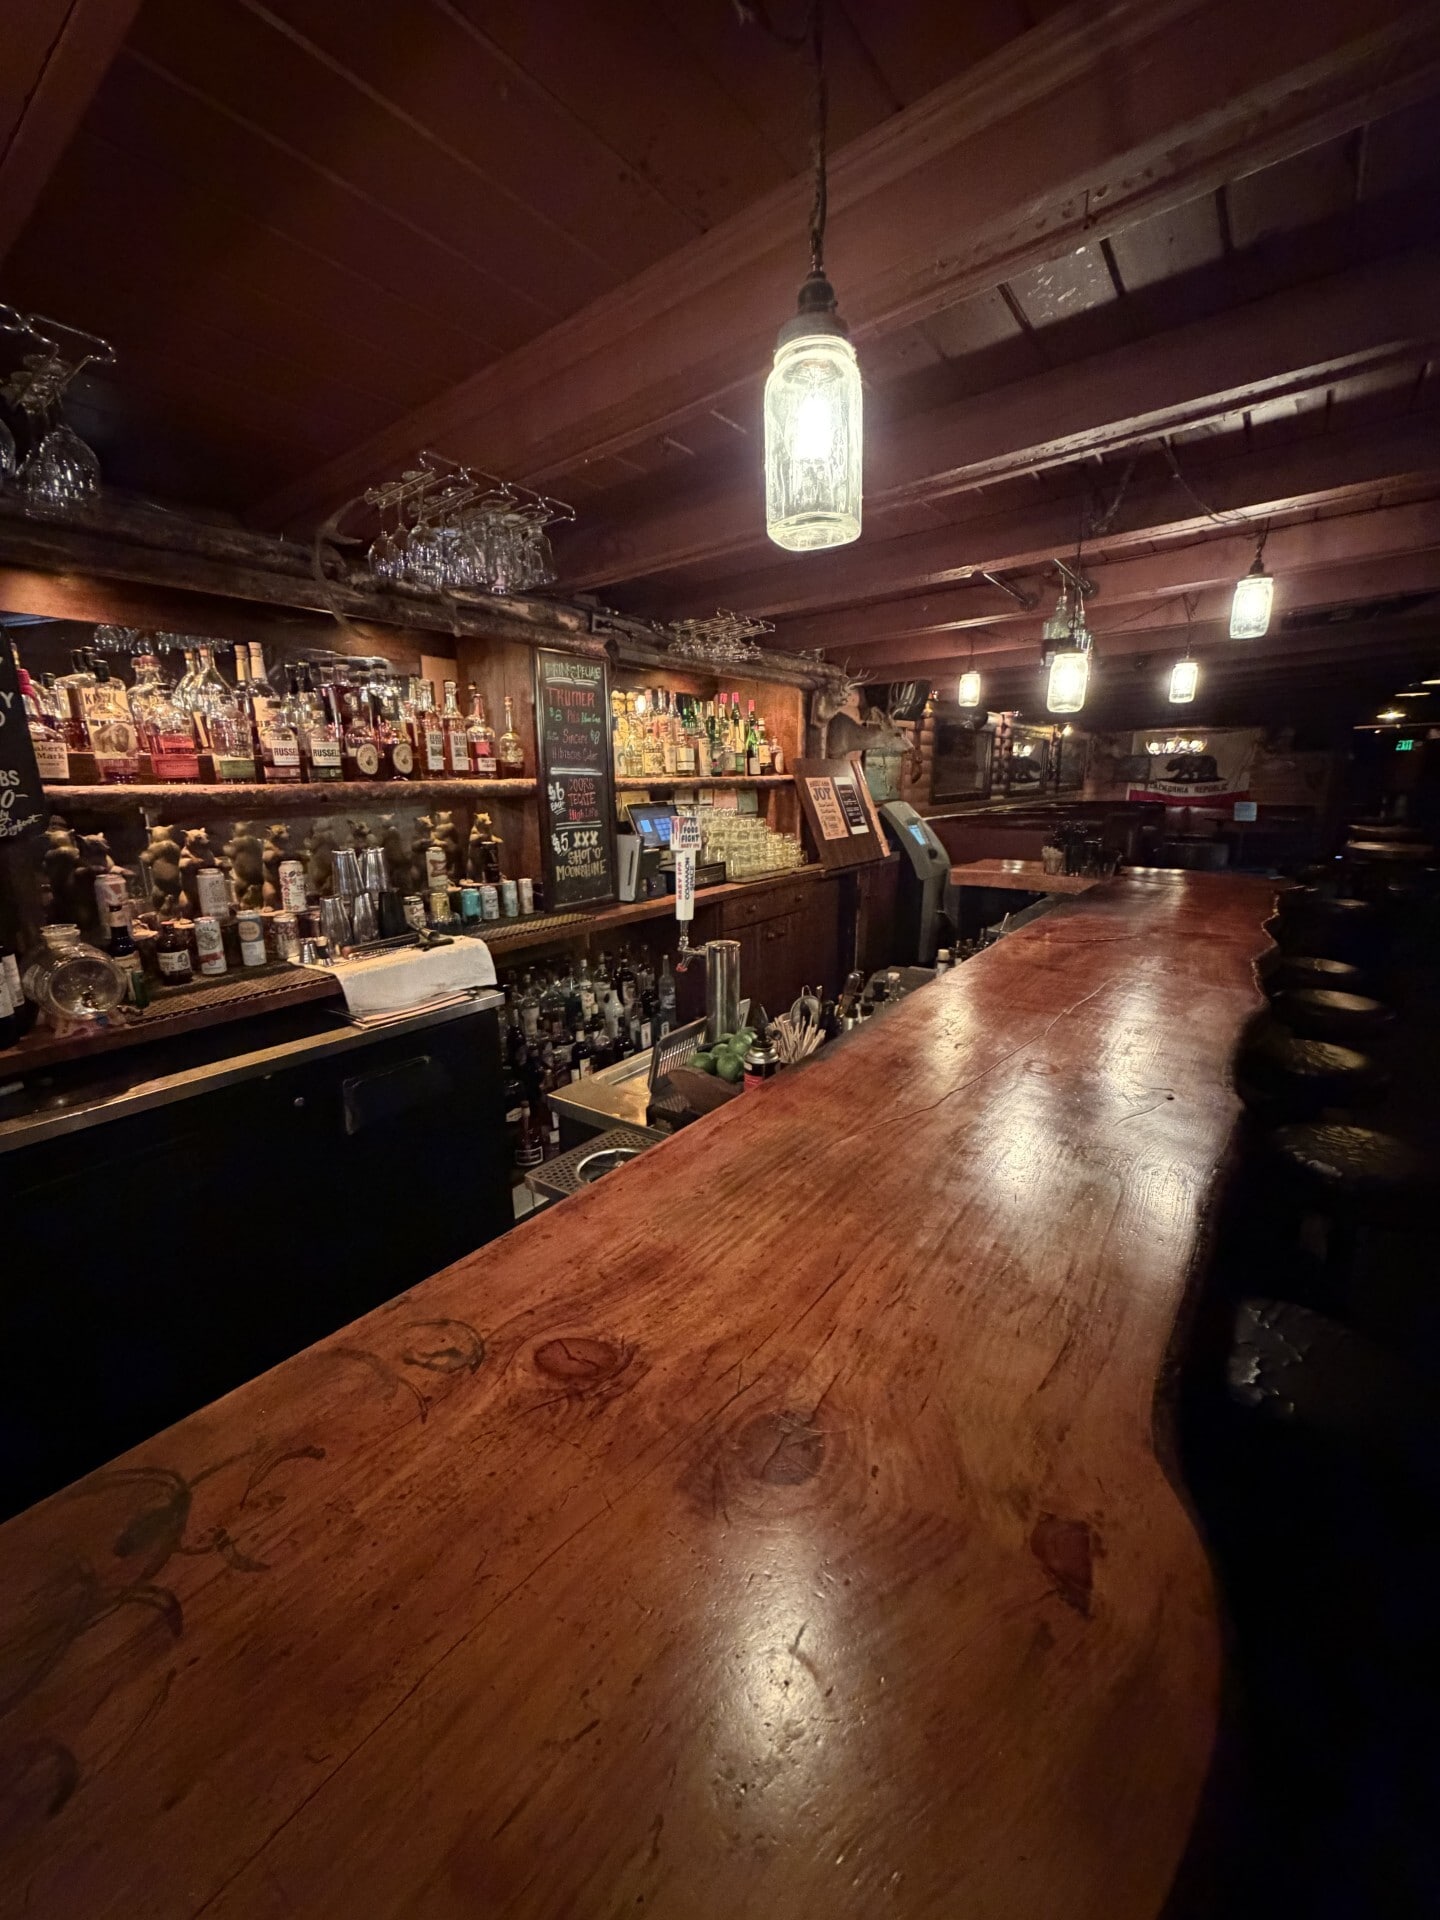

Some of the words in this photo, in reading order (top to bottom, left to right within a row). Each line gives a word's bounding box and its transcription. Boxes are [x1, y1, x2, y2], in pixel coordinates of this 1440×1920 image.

[37, 744, 65, 752] aker's
[813, 787, 832, 801] JOY
[573, 830, 599, 848] XXX
[568, 847, 592, 865] SHOT
[555, 858, 607, 882] MOONSHINE
